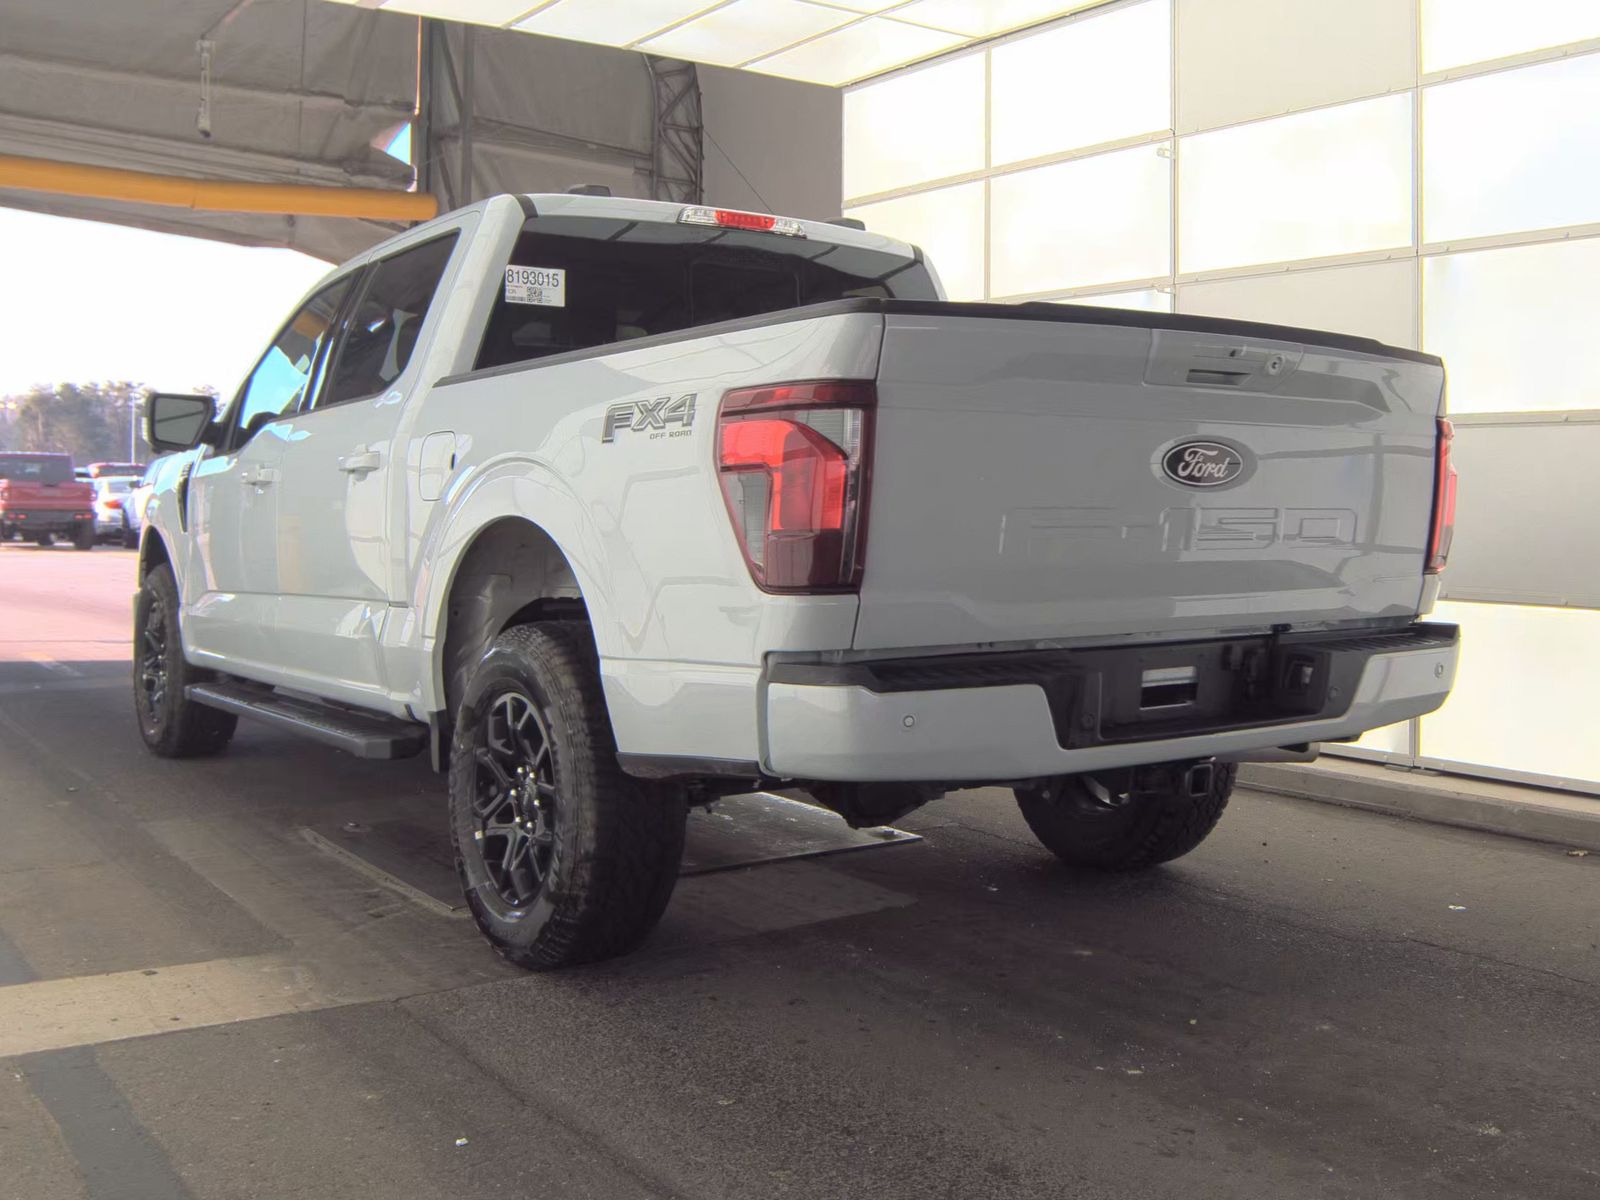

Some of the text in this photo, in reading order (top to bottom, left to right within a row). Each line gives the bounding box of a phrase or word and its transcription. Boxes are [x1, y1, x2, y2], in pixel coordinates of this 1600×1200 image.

[506, 269, 559, 288] 8193015
[602, 393, 698, 443] FX4
[649, 429, 692, 440] OFF ROAD
[1177, 447, 1231, 478] Ford
